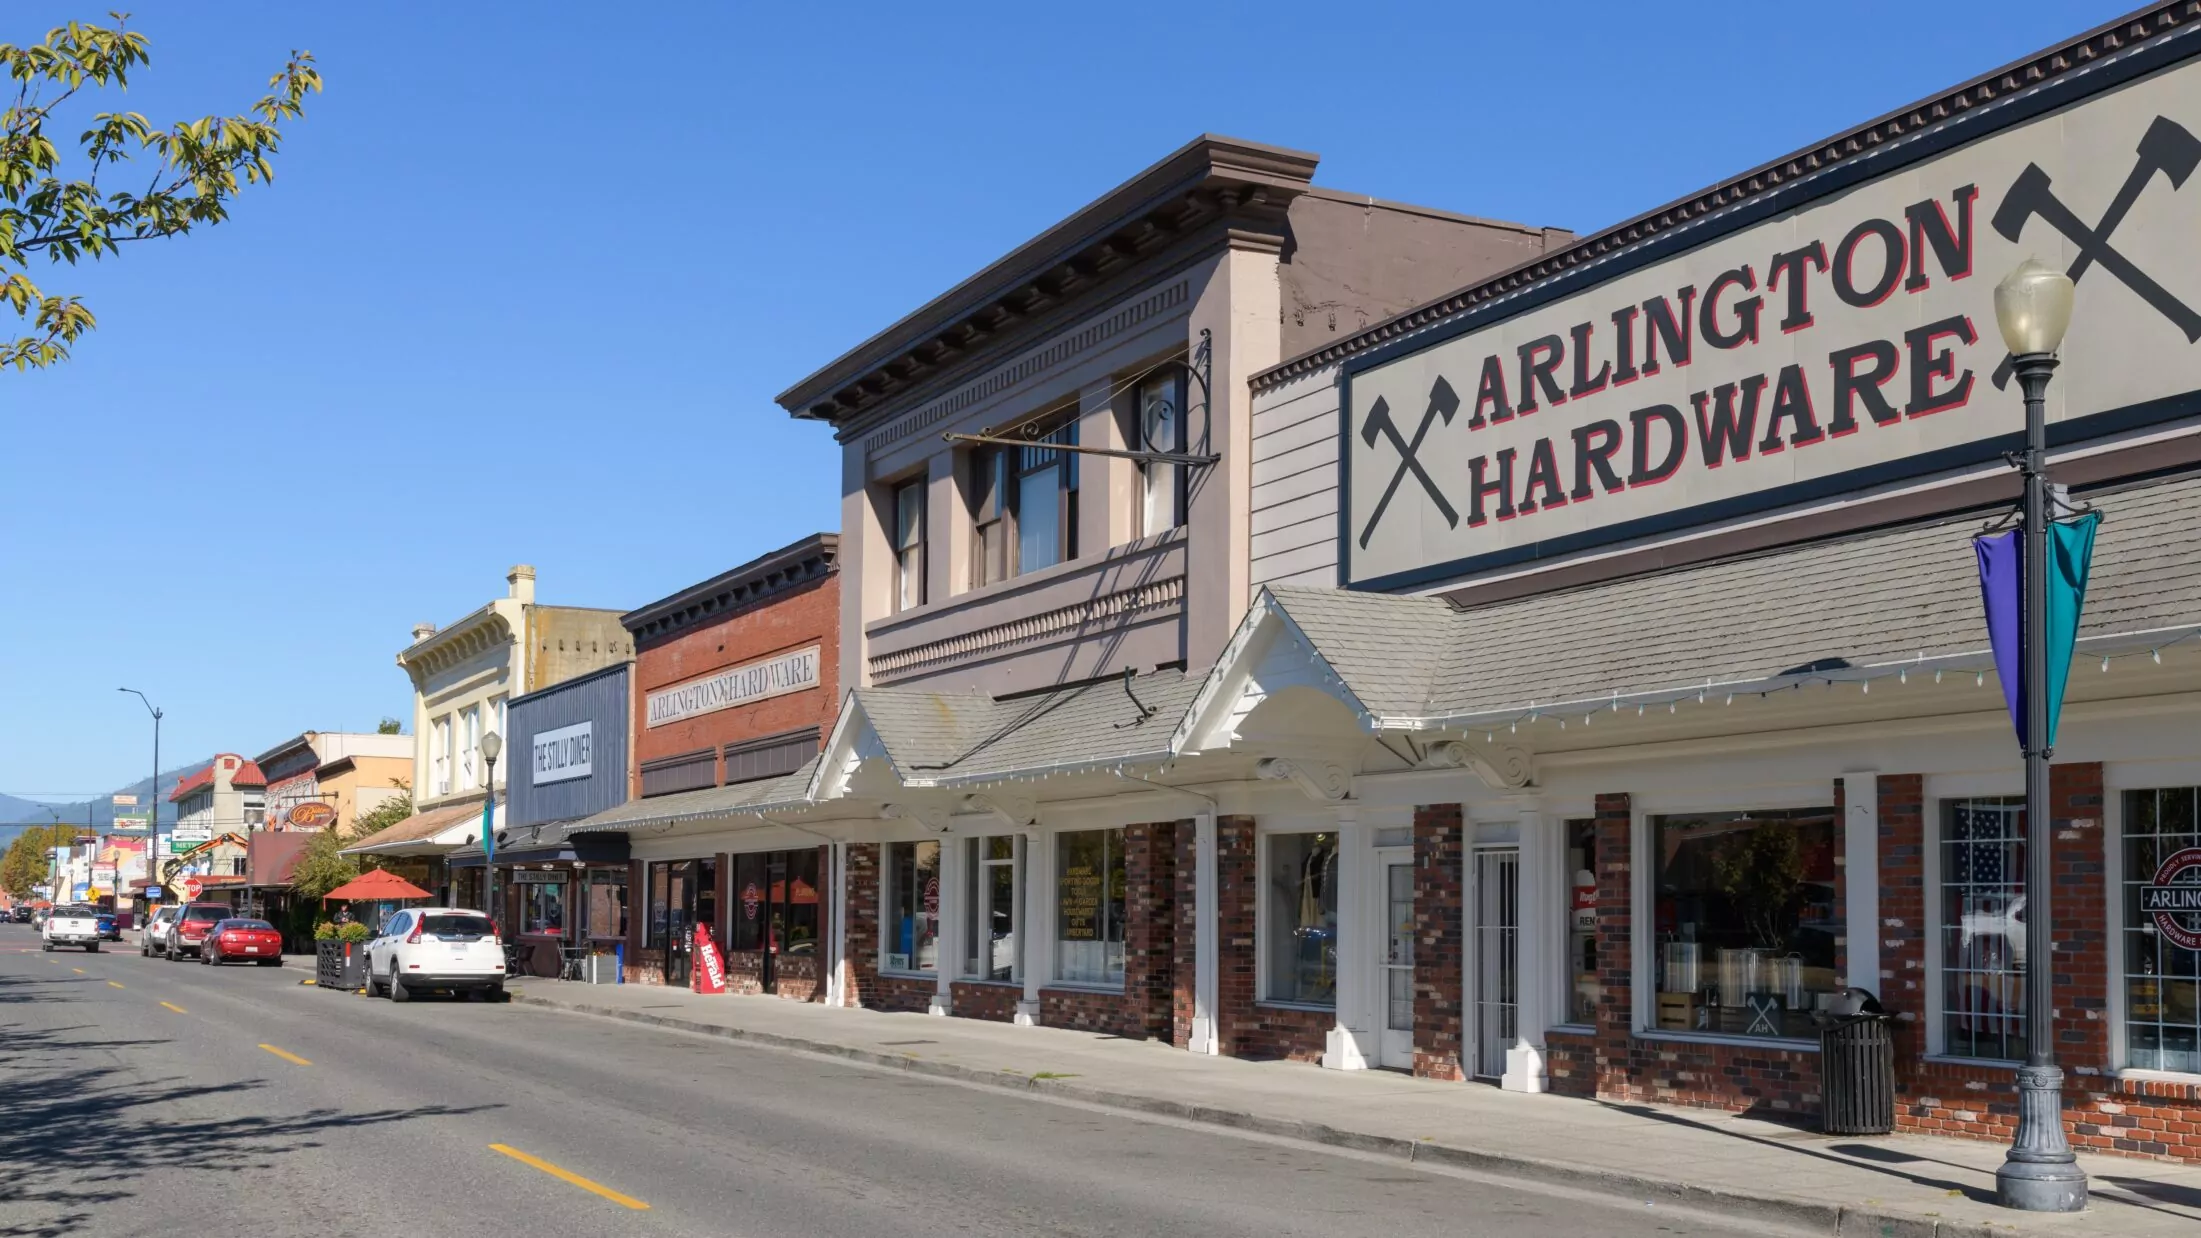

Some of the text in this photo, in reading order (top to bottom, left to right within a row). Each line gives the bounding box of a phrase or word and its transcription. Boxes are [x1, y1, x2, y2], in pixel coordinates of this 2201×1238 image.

[1468, 183, 1979, 431] ARLINGTON
[1467, 314, 1978, 528] HARDWARE
[650, 653, 813, 722] ARLINGTON HARDWARE
[534, 732, 591, 773] THE STILLY DINER
[517, 872, 527, 881] THE
[2160, 854, 2201, 881] PROUDLY SERVIN
[1580, 916, 1596, 927] REN
[2159, 914, 2197, 946] HARDWARE
[700, 943, 725, 989] Herald
[1755, 1023, 1769, 1033] AH
